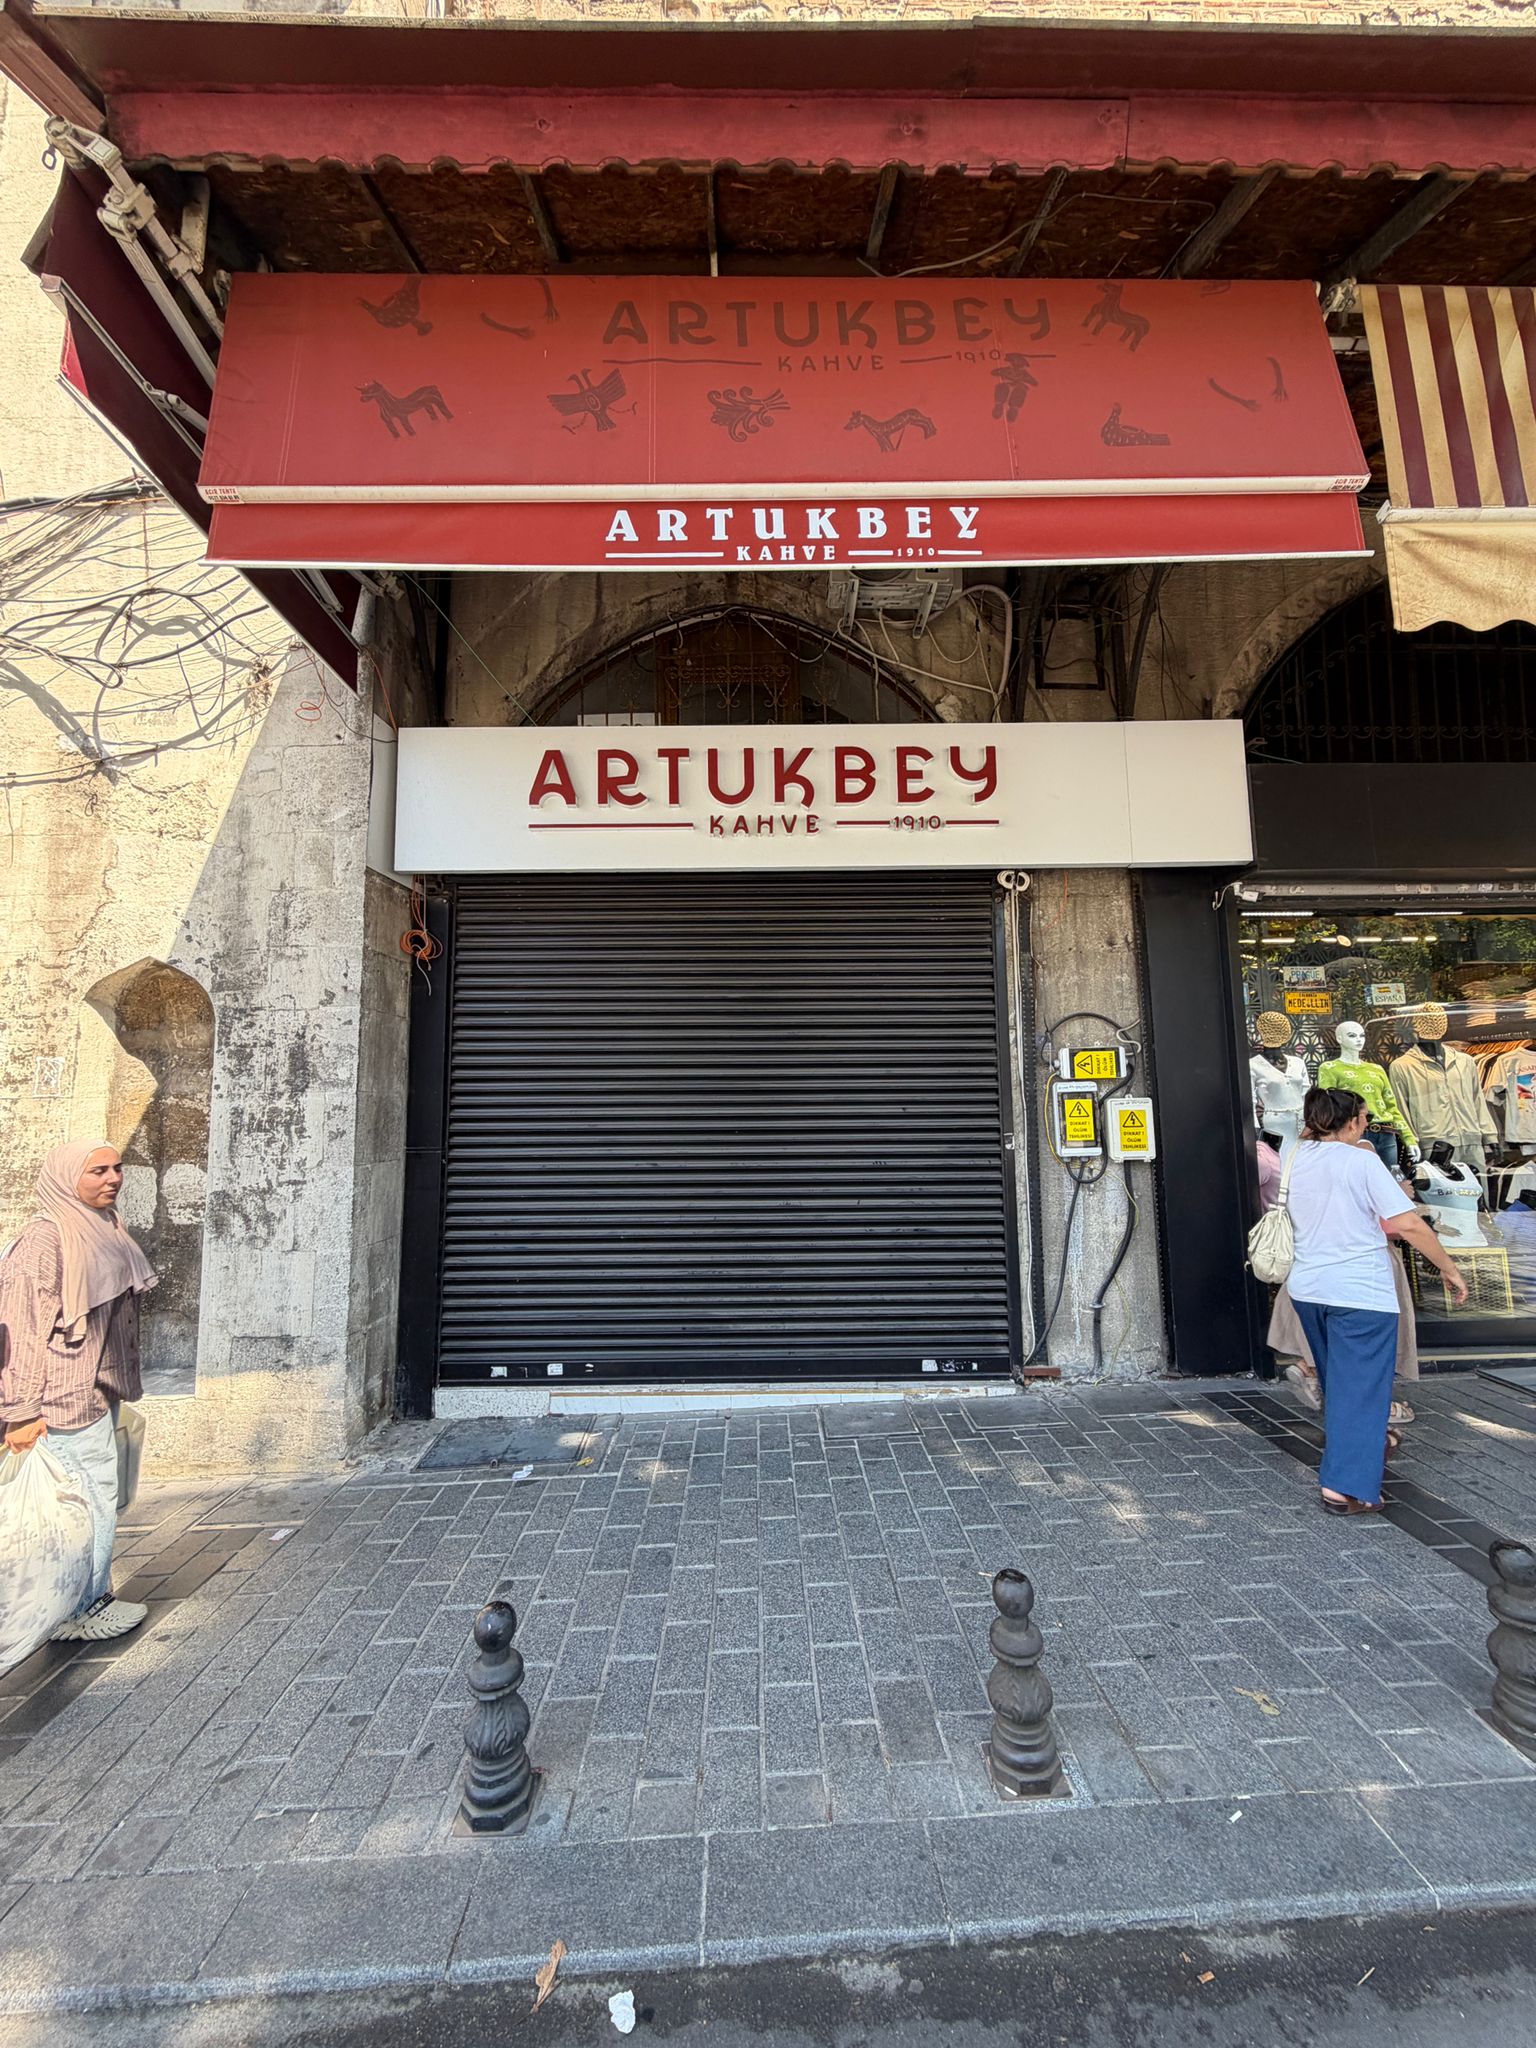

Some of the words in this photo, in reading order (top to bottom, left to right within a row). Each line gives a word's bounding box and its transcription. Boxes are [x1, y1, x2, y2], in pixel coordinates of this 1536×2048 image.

[602, 297, 1052, 350] ARTUKBEY
[777, 354, 885, 373] KAHVE
[955, 348, 1001, 364] 1910
[605, 506, 981, 542] ARTUKBEY
[736, 545, 836, 562] KAHVE
[896, 546, 936, 558] 1910
[528, 745, 998, 808] ARTUKBEY
[709, 814, 821, 838] KAHVE
[892, 814, 943, 831] 1910
